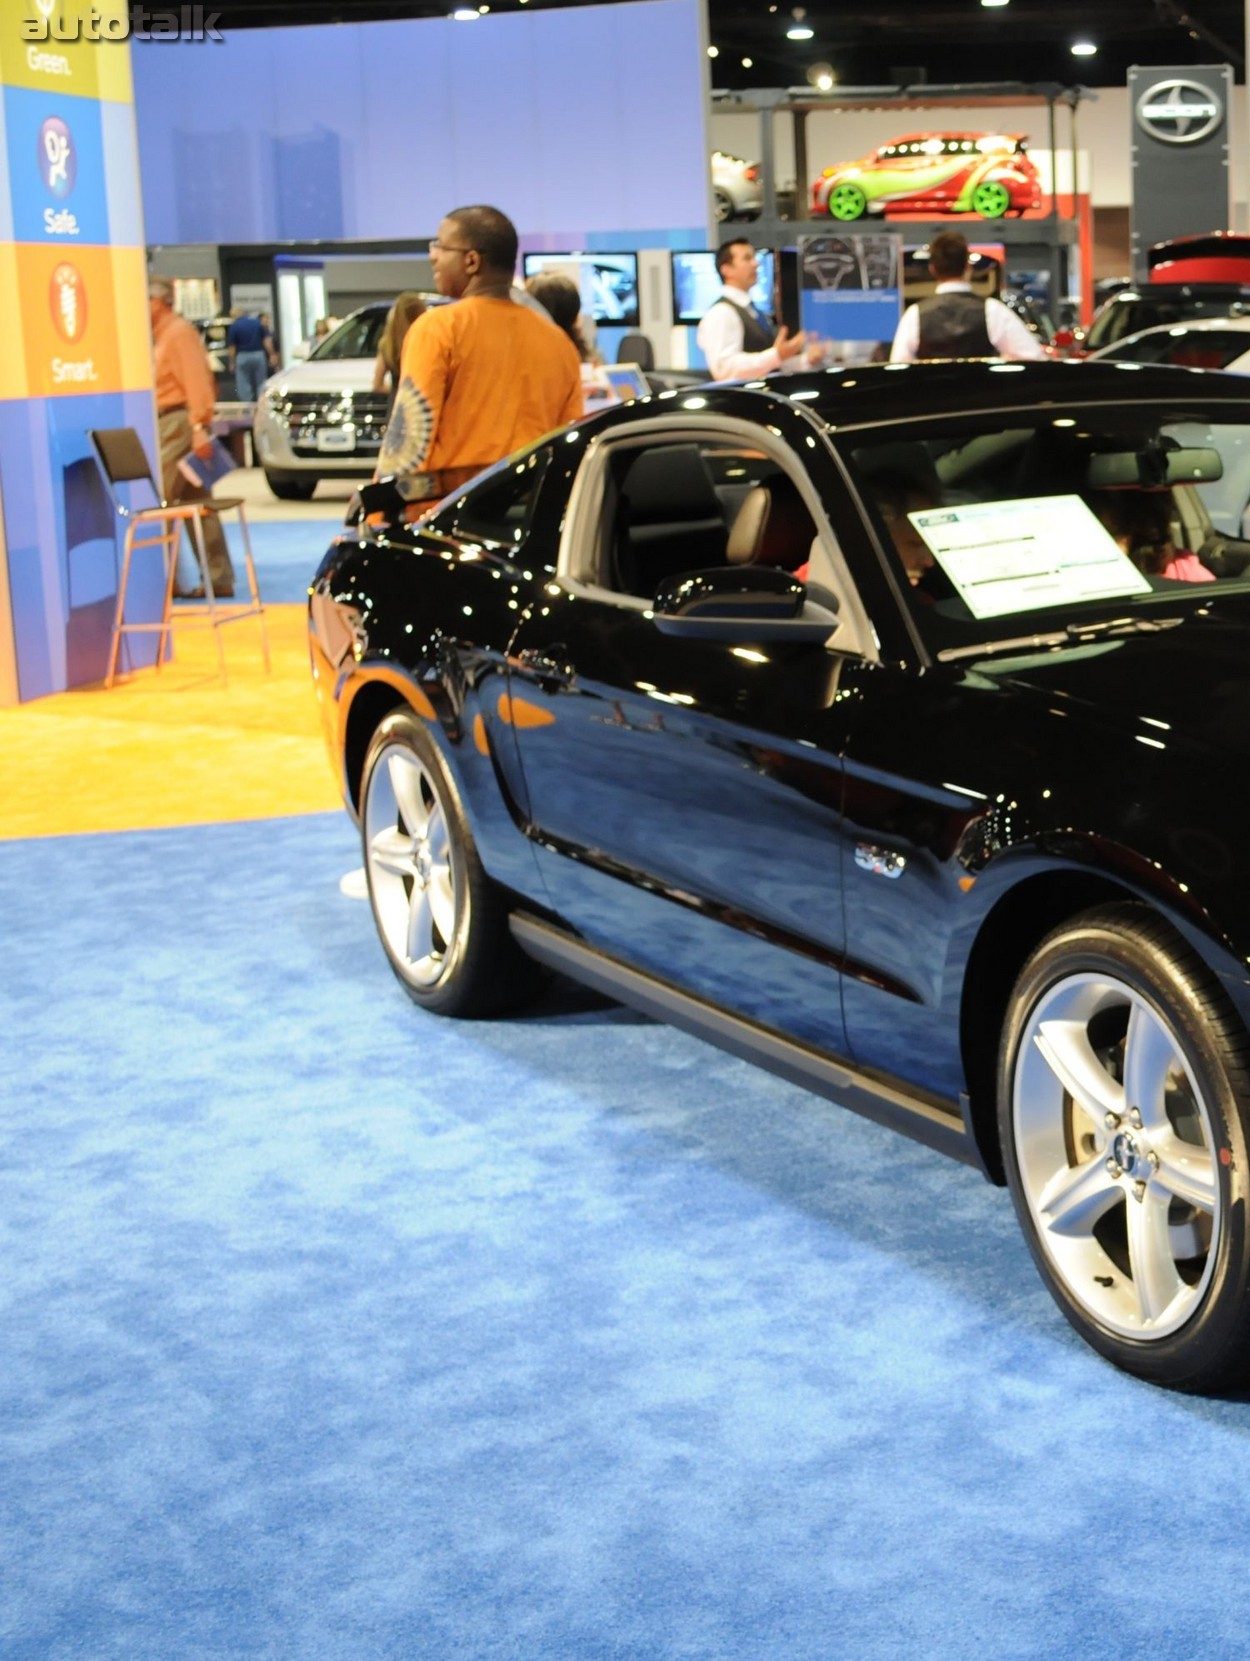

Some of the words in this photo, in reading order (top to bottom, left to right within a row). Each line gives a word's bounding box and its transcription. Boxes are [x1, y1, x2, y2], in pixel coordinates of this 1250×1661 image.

[26, 46, 72, 76] Green.
[43, 208, 80, 235] Safe.
[52, 357, 98, 382] Smart.
